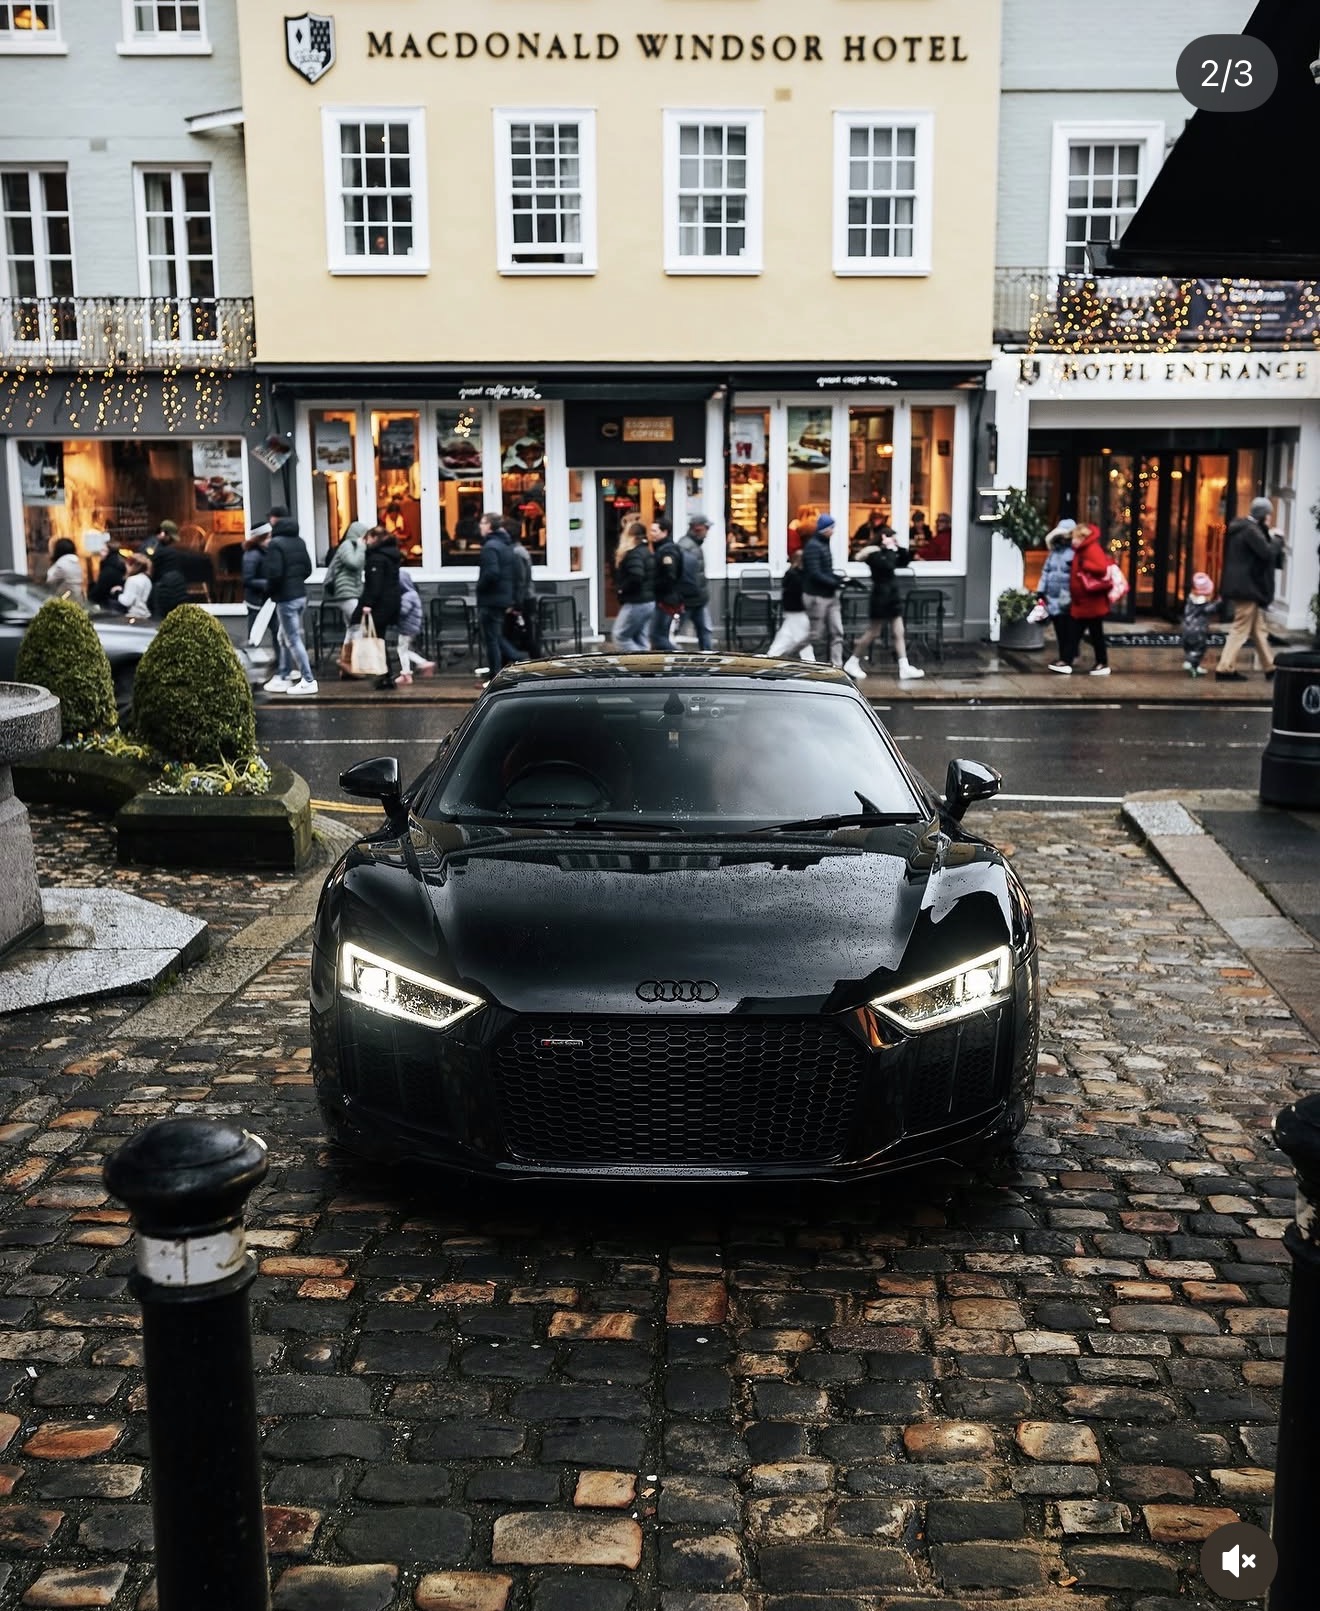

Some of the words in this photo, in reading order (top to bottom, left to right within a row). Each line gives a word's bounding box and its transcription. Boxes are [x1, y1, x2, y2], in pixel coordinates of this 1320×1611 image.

[367, 31, 619, 60] MACDONALD
[636, 33, 823, 62] WINDSOR
[844, 35, 968, 63] HOTEL
[1063, 361, 1150, 381] HOTEL
[1164, 361, 1308, 381] ENTRANCE
[630, 430, 666, 438] COFFEE
